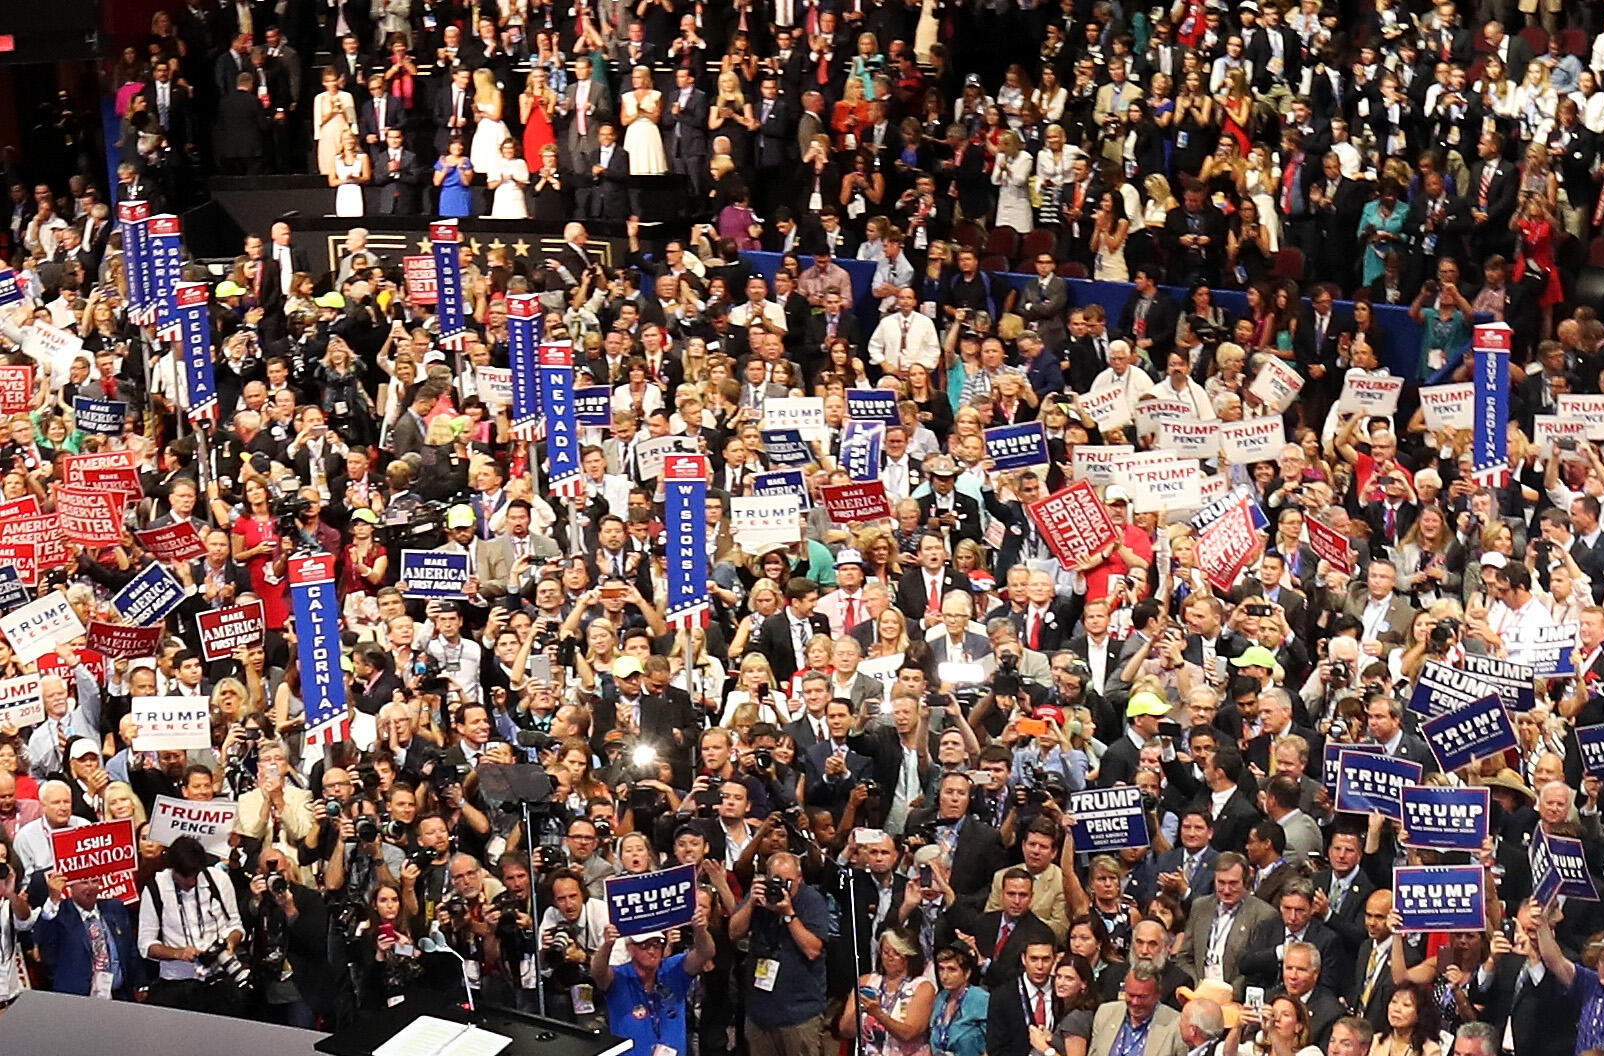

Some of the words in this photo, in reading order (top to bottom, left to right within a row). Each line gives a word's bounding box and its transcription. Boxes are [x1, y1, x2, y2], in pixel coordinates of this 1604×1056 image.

[441, 247, 456, 325] MISSOURI
[188, 310, 207, 392] GEORGIA
[1268, 362, 1301, 390] TRUMP
[1486, 353, 1498, 391] SOUTH
[1349, 378, 1400, 391] TRUMP
[1354, 391, 1383, 400] PENCE
[1423, 390, 1474, 404] TRUMP
[848, 399, 894, 410] TRUMP
[1137, 403, 1190, 415] TRUMP
[1434, 404, 1462, 413] PENCE
[75, 412, 124, 424] AMERICA
[550, 375, 569, 462] NEVADA
[767, 409, 822, 418] TRUMP
[1163, 423, 1218, 435] TRUMP
[1224, 422, 1280, 440] TRUMP
[1485, 396, 1498, 459] CAROLINA
[1537, 422, 1584, 433] TRUMP
[987, 433, 1041, 451] TRUMP
[1173, 436, 1206, 444] PENCE
[1236, 437, 1269, 447] PENCE
[70, 454, 130, 470] AMERICA
[1136, 467, 1196, 482] TRUMP
[1150, 481, 1184, 492] PENCE
[57, 491, 108, 507] AMERICA
[826, 494, 886, 511] AMERICA
[58, 503, 110, 518] DESERVES
[734, 507, 796, 518] TRUMP
[1074, 490, 1112, 543] AMERICA
[60, 514, 115, 533] BETTER
[1047, 499, 1090, 558] BETTER
[1062, 493, 1099, 550] DESERVES
[678, 485, 694, 594] WISCONSIN
[424, 558, 447, 566] MAKE
[404, 568, 466, 580] AMERICA
[409, 580, 432, 590] FIRST
[433, 580, 461, 590] AGAIN
[123, 576, 175, 619] AMERICA
[7, 602, 68, 638] TRUMP
[220, 611, 245, 623] MAKE
[16, 614, 71, 644] PENCE
[203, 618, 264, 641] AMERICA
[90, 633, 158, 649] AMERICA
[211, 638, 235, 651] FIRST
[236, 632, 259, 647] AGAIN
[308, 586, 332, 710] CALIFORNIA
[1465, 656, 1534, 681] TRUMP
[136, 710, 207, 721] TRUMP
[1432, 707, 1502, 746] TRUMP
[1443, 723, 1500, 752] PENCE
[1344, 767, 1416, 789] TRUMP
[1350, 781, 1400, 797] PENC
[1071, 789, 1140, 812] TRUMP
[159, 804, 234, 824] TRUMP
[1406, 802, 1483, 818] TRUMP
[171, 820, 216, 835] PENCE
[1085, 817, 1129, 833] PENCE
[1412, 816, 1475, 827] PENCE
[75, 834, 112, 852] FIRST
[58, 844, 134, 874] COUNTRY
[612, 881, 691, 907] TRUMP
[1399, 884, 1478, 899] TRUMP
[621, 896, 685, 916] PENCE
[1404, 899, 1471, 908] PENCE
